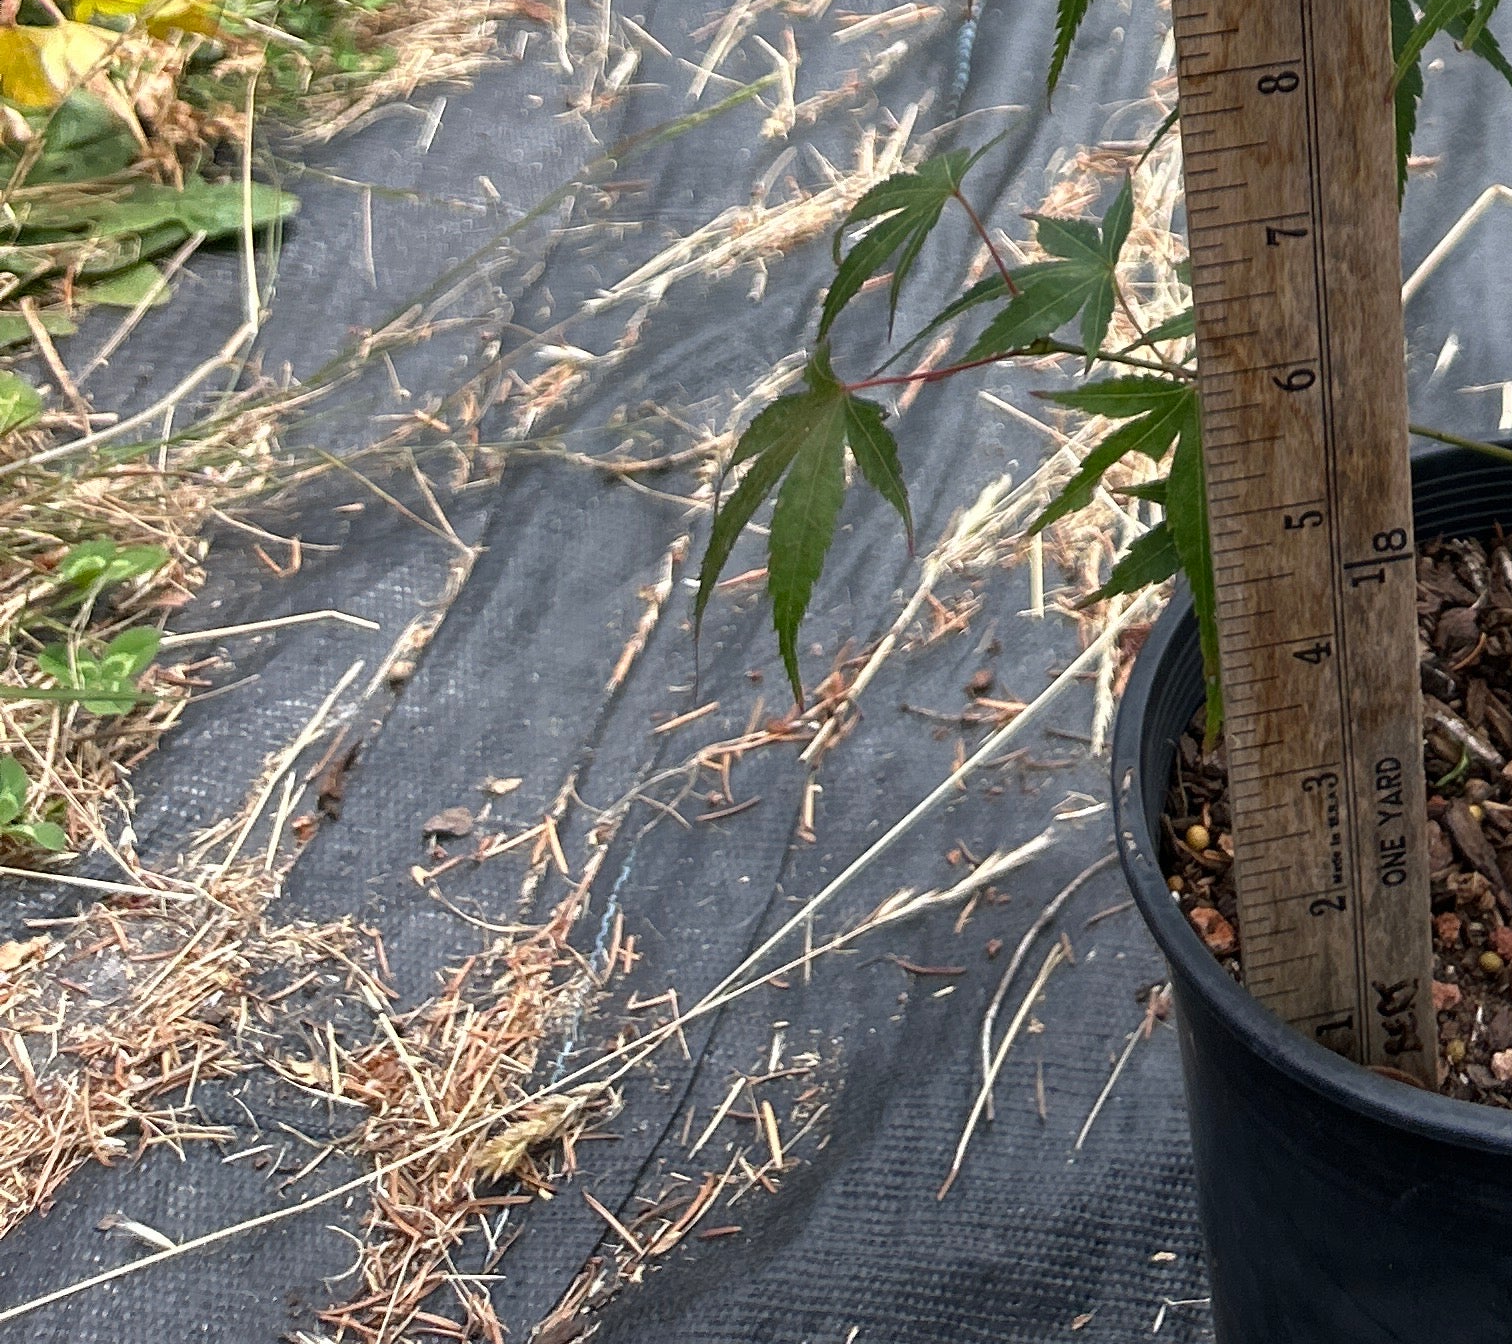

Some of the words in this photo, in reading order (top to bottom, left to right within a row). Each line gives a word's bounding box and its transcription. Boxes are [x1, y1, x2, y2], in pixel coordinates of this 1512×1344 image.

[1257, 69, 1300, 94] 8
[1265, 226, 1308, 246] 7
[1272, 365, 1316, 393] 6
[1284, 510, 1324, 531] 5
[1294, 640, 1331, 666] 4
[1302, 772, 1339, 793] 3
[1375, 757, 1403, 827] YARD
[1381, 835, 1407, 889] ONE
[1309, 895, 1347, 917] 2
[1315, 1013, 1354, 1038] 1
